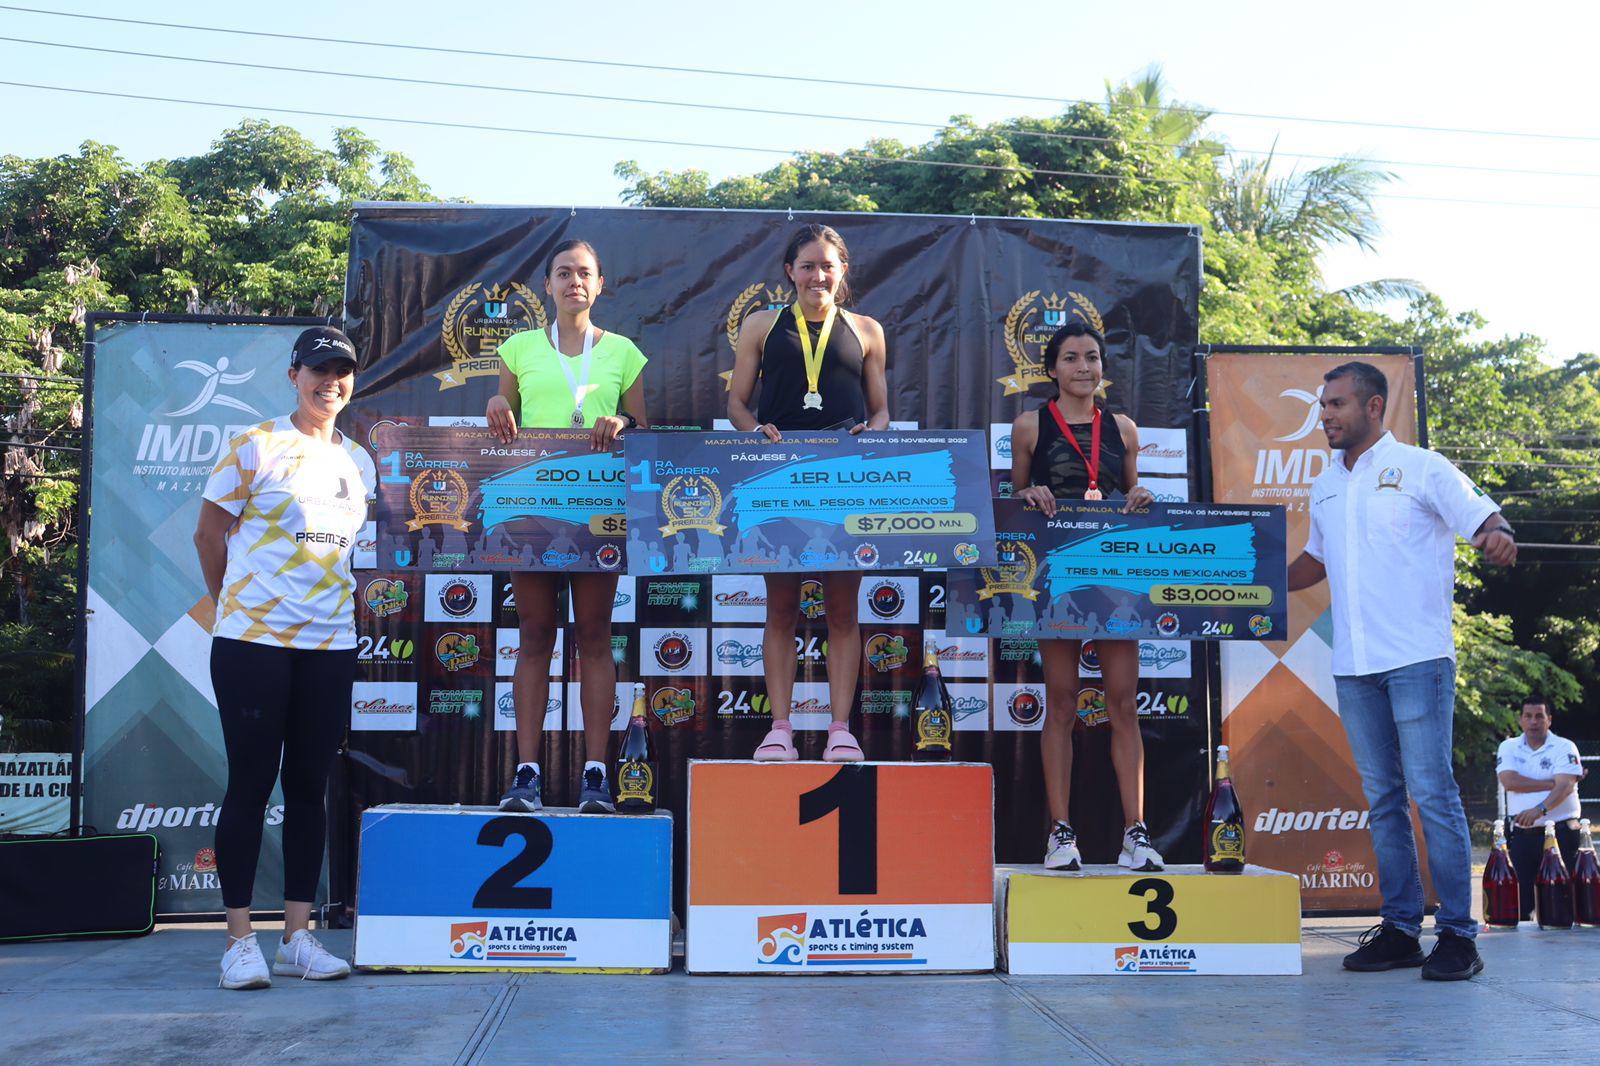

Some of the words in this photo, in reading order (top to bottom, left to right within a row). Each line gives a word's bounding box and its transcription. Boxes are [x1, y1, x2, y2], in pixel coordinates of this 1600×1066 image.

[405, 452, 424, 460] RA
[480, 446, 536, 457] PÁGUESE
[731, 452, 787, 461] PÁGUESE
[405, 460, 469, 469] CARRERA
[655, 460, 674, 468] RA
[133, 466, 179, 476] INSTITUTO
[536, 470, 580, 482] 2DO
[655, 467, 720, 475] CARRERA
[790, 471, 830, 484] 1ER
[837, 471, 912, 484] LUGAR
[1252, 488, 1292, 497] INSTITUTO
[430, 502, 450, 512] 5K
[496, 496, 537, 505] CINCO
[541, 498, 563, 506] MIL
[568, 498, 613, 507] PESOS
[752, 500, 789, 509] SIETE
[793, 499, 816, 507] MIL
[820, 498, 865, 507] PESOS
[870, 497, 948, 506] MEXICANOS
[683, 507, 705, 517] 5K
[857, 516, 936, 533] $7,000
[1101, 541, 1139, 553] 3ER
[1147, 542, 1216, 555] LUGAR
[1065, 567, 1098, 576] TRES
[1102, 568, 1123, 576] MIL
[1127, 568, 1169, 577] PESOS
[1173, 569, 1247, 578] MEXICANOS
[1161, 587, 1236, 603] $3,000
[0, 783, 20, 797] DE
[25, 783, 44, 797] LA
[799, 765, 877, 895] 1
[472, 815, 553, 910] 2
[1302, 873, 1374, 889] MARINO
[1127, 877, 1178, 941] 3
[518, 943, 540, 952] timing
[808, 943, 838, 951] sports
[850, 942, 878, 953] timing
[881, 942, 914, 951] system
